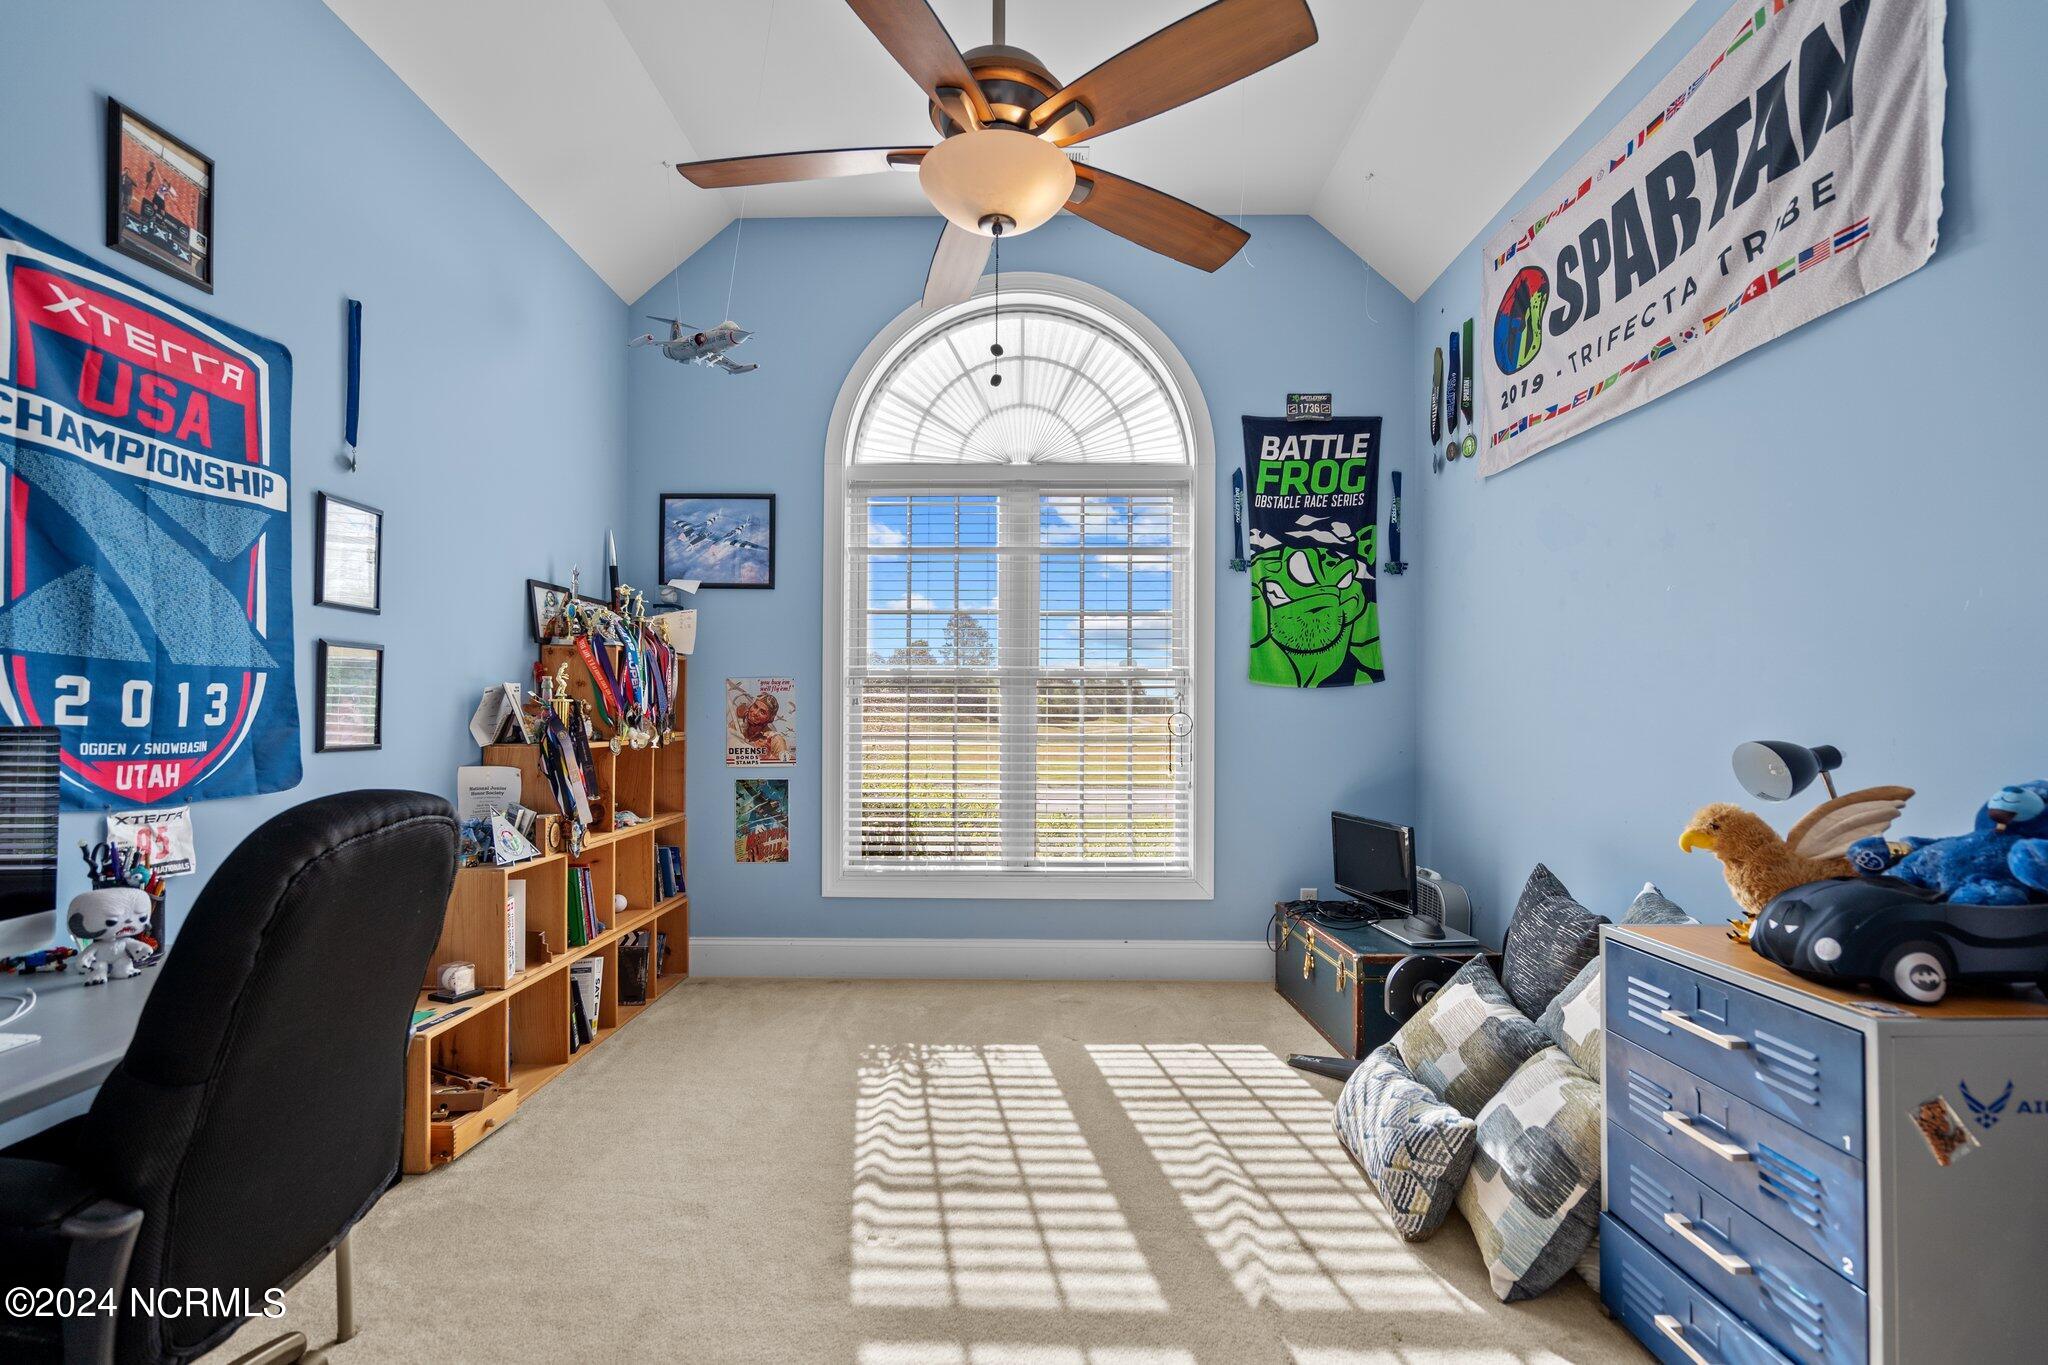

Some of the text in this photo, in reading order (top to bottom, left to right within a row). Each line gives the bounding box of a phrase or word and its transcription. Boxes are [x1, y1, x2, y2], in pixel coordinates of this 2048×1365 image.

[1548, 0, 1870, 336] SPARTAN
[1501, 373, 1544, 410] 2019
[1568, 276, 1698, 373] TRIFECTA
[1717, 171, 1836, 277] TRIBE
[78, 350, 212, 449] USA
[1300, 404, 1320, 413] 1736
[1260, 433, 1370, 460] BATTLE
[1256, 459, 1367, 496] FROG
[1254, 493, 1365, 509] OBSTACLE RACE SERIES
[80, 742, 127, 756] OGDEN
[144, 740, 208, 754] SNOWBASIN
[728, 747, 766, 755] DEFENSE
[116, 763, 181, 790] UTAH
[2017, 1100, 2048, 1114] AI
[1842, 1135, 1851, 1151] 1
[1842, 1257, 1854, 1276] 2
